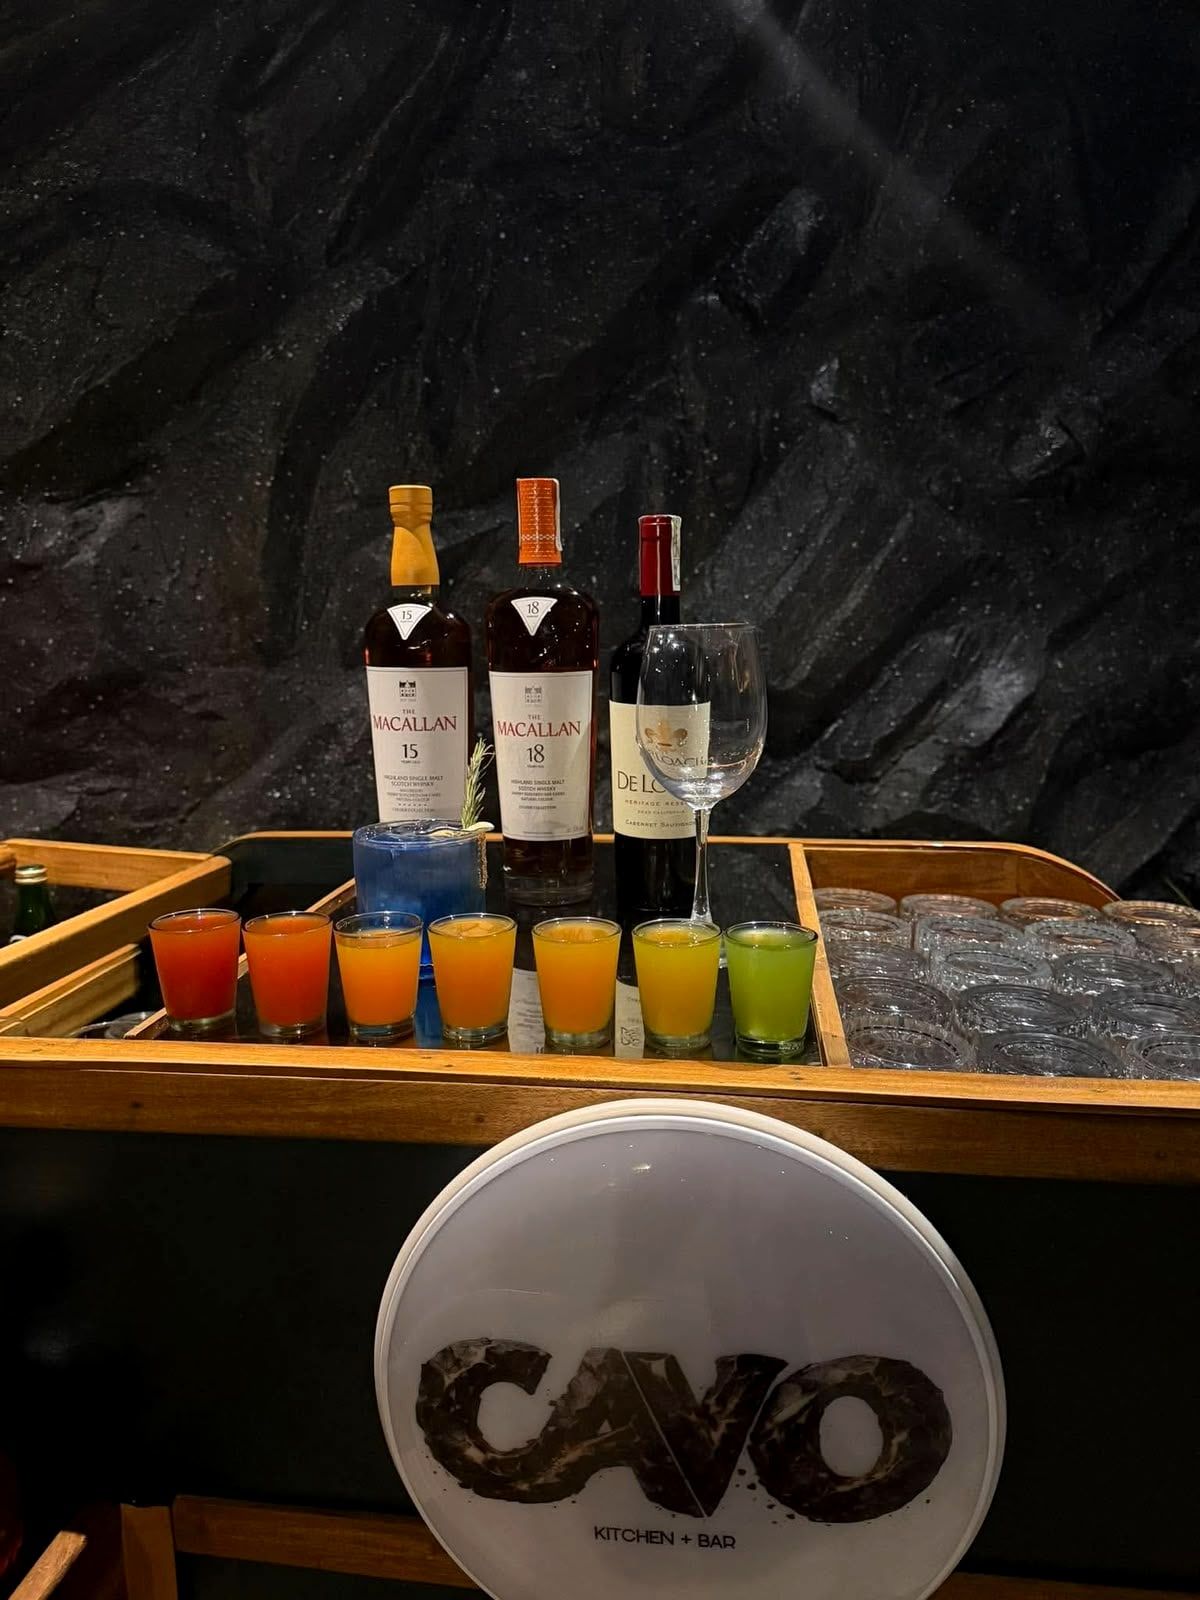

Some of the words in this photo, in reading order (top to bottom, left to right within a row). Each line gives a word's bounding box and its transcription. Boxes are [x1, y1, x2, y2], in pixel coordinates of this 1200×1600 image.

[402, 610, 413, 620] 15
[527, 601, 540, 614] 18
[373, 715, 457, 732] MACALLAN
[497, 720, 581, 737] MACALLAN
[402, 743, 419, 759] 15
[526, 743, 545, 763] 18
[617, 770, 638, 792] DE
[625, 818, 657, 828] CABERNET
[593, 1525, 675, 1545] KITCHEN
[697, 1533, 736, 1550] BAR
